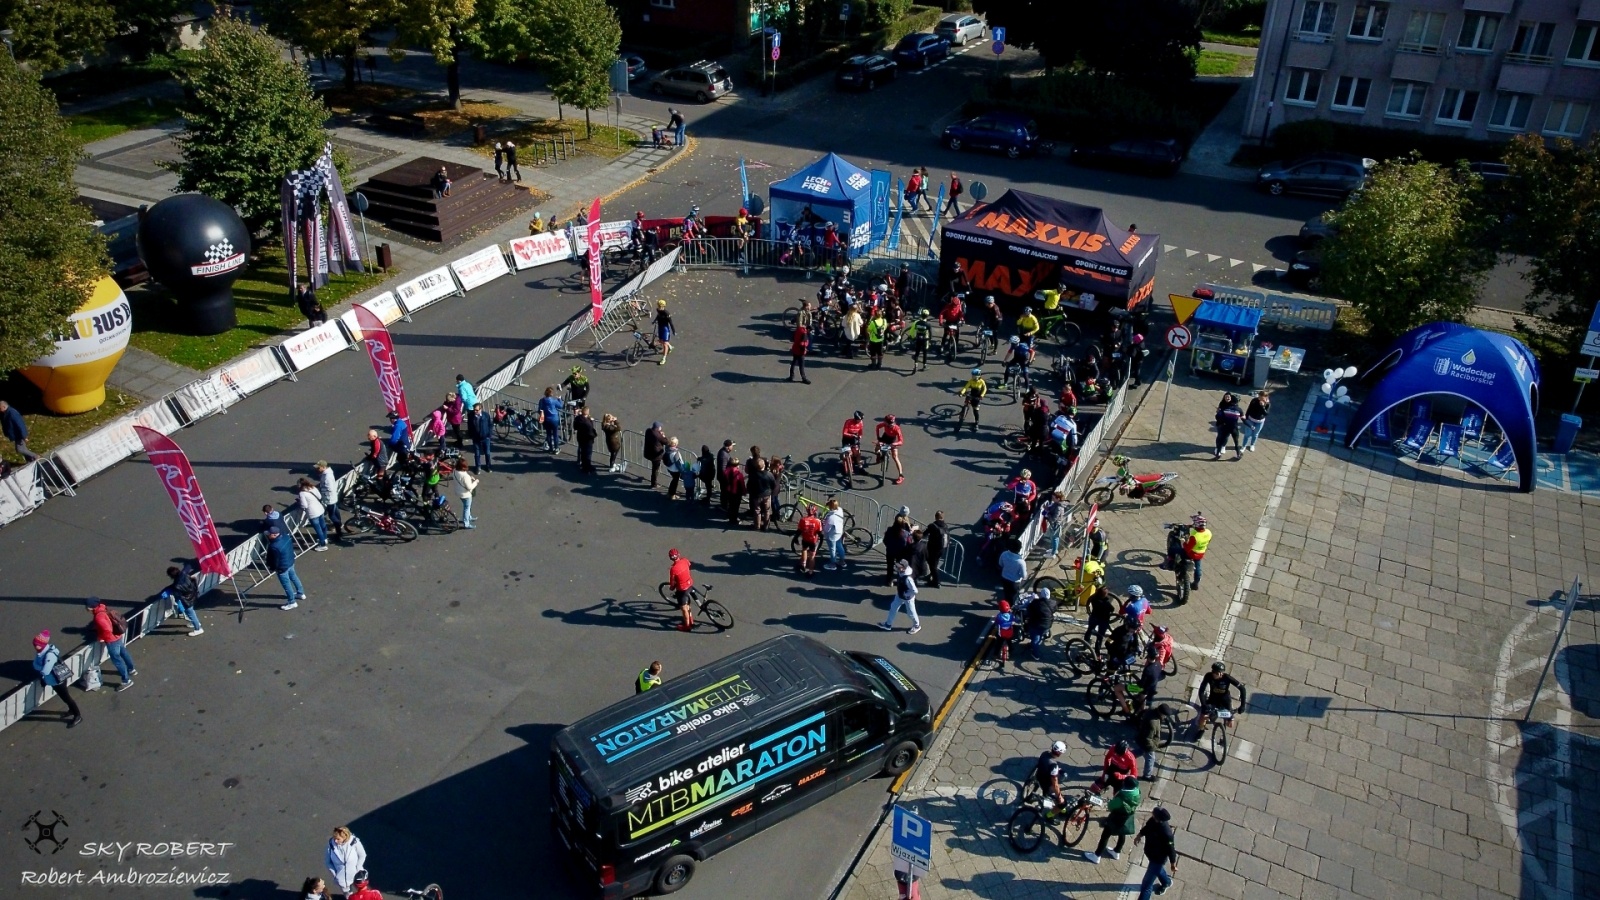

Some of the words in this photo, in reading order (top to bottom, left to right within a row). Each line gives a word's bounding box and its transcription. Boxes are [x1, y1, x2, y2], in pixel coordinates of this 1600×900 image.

[801, 182, 830, 194] FREE
[805, 175, 827, 186] LECH
[945, 231, 967, 241] OPONY
[967, 235, 993, 246] MAXXIS
[976, 211, 1107, 253] MAXXIS
[1009, 245, 1031, 255] OPONY
[1031, 250, 1059, 261] MAXXIS
[196, 263, 226, 274] FINISH
[228, 257, 242, 267] LINE
[1075, 259, 1098, 270] OPONY
[1098, 265, 1128, 276] MAXXIS
[1450, 370, 1494, 386] Raciborskie
[1452, 363, 1497, 380] Wodociągi
[712, 701, 741, 717] bike
[676, 713, 712, 735] atelier
[658, 767, 694, 792] bike
[697, 742, 746, 773] atelier
[901, 812, 924, 839] P
[893, 845, 916, 863] Wjazd
